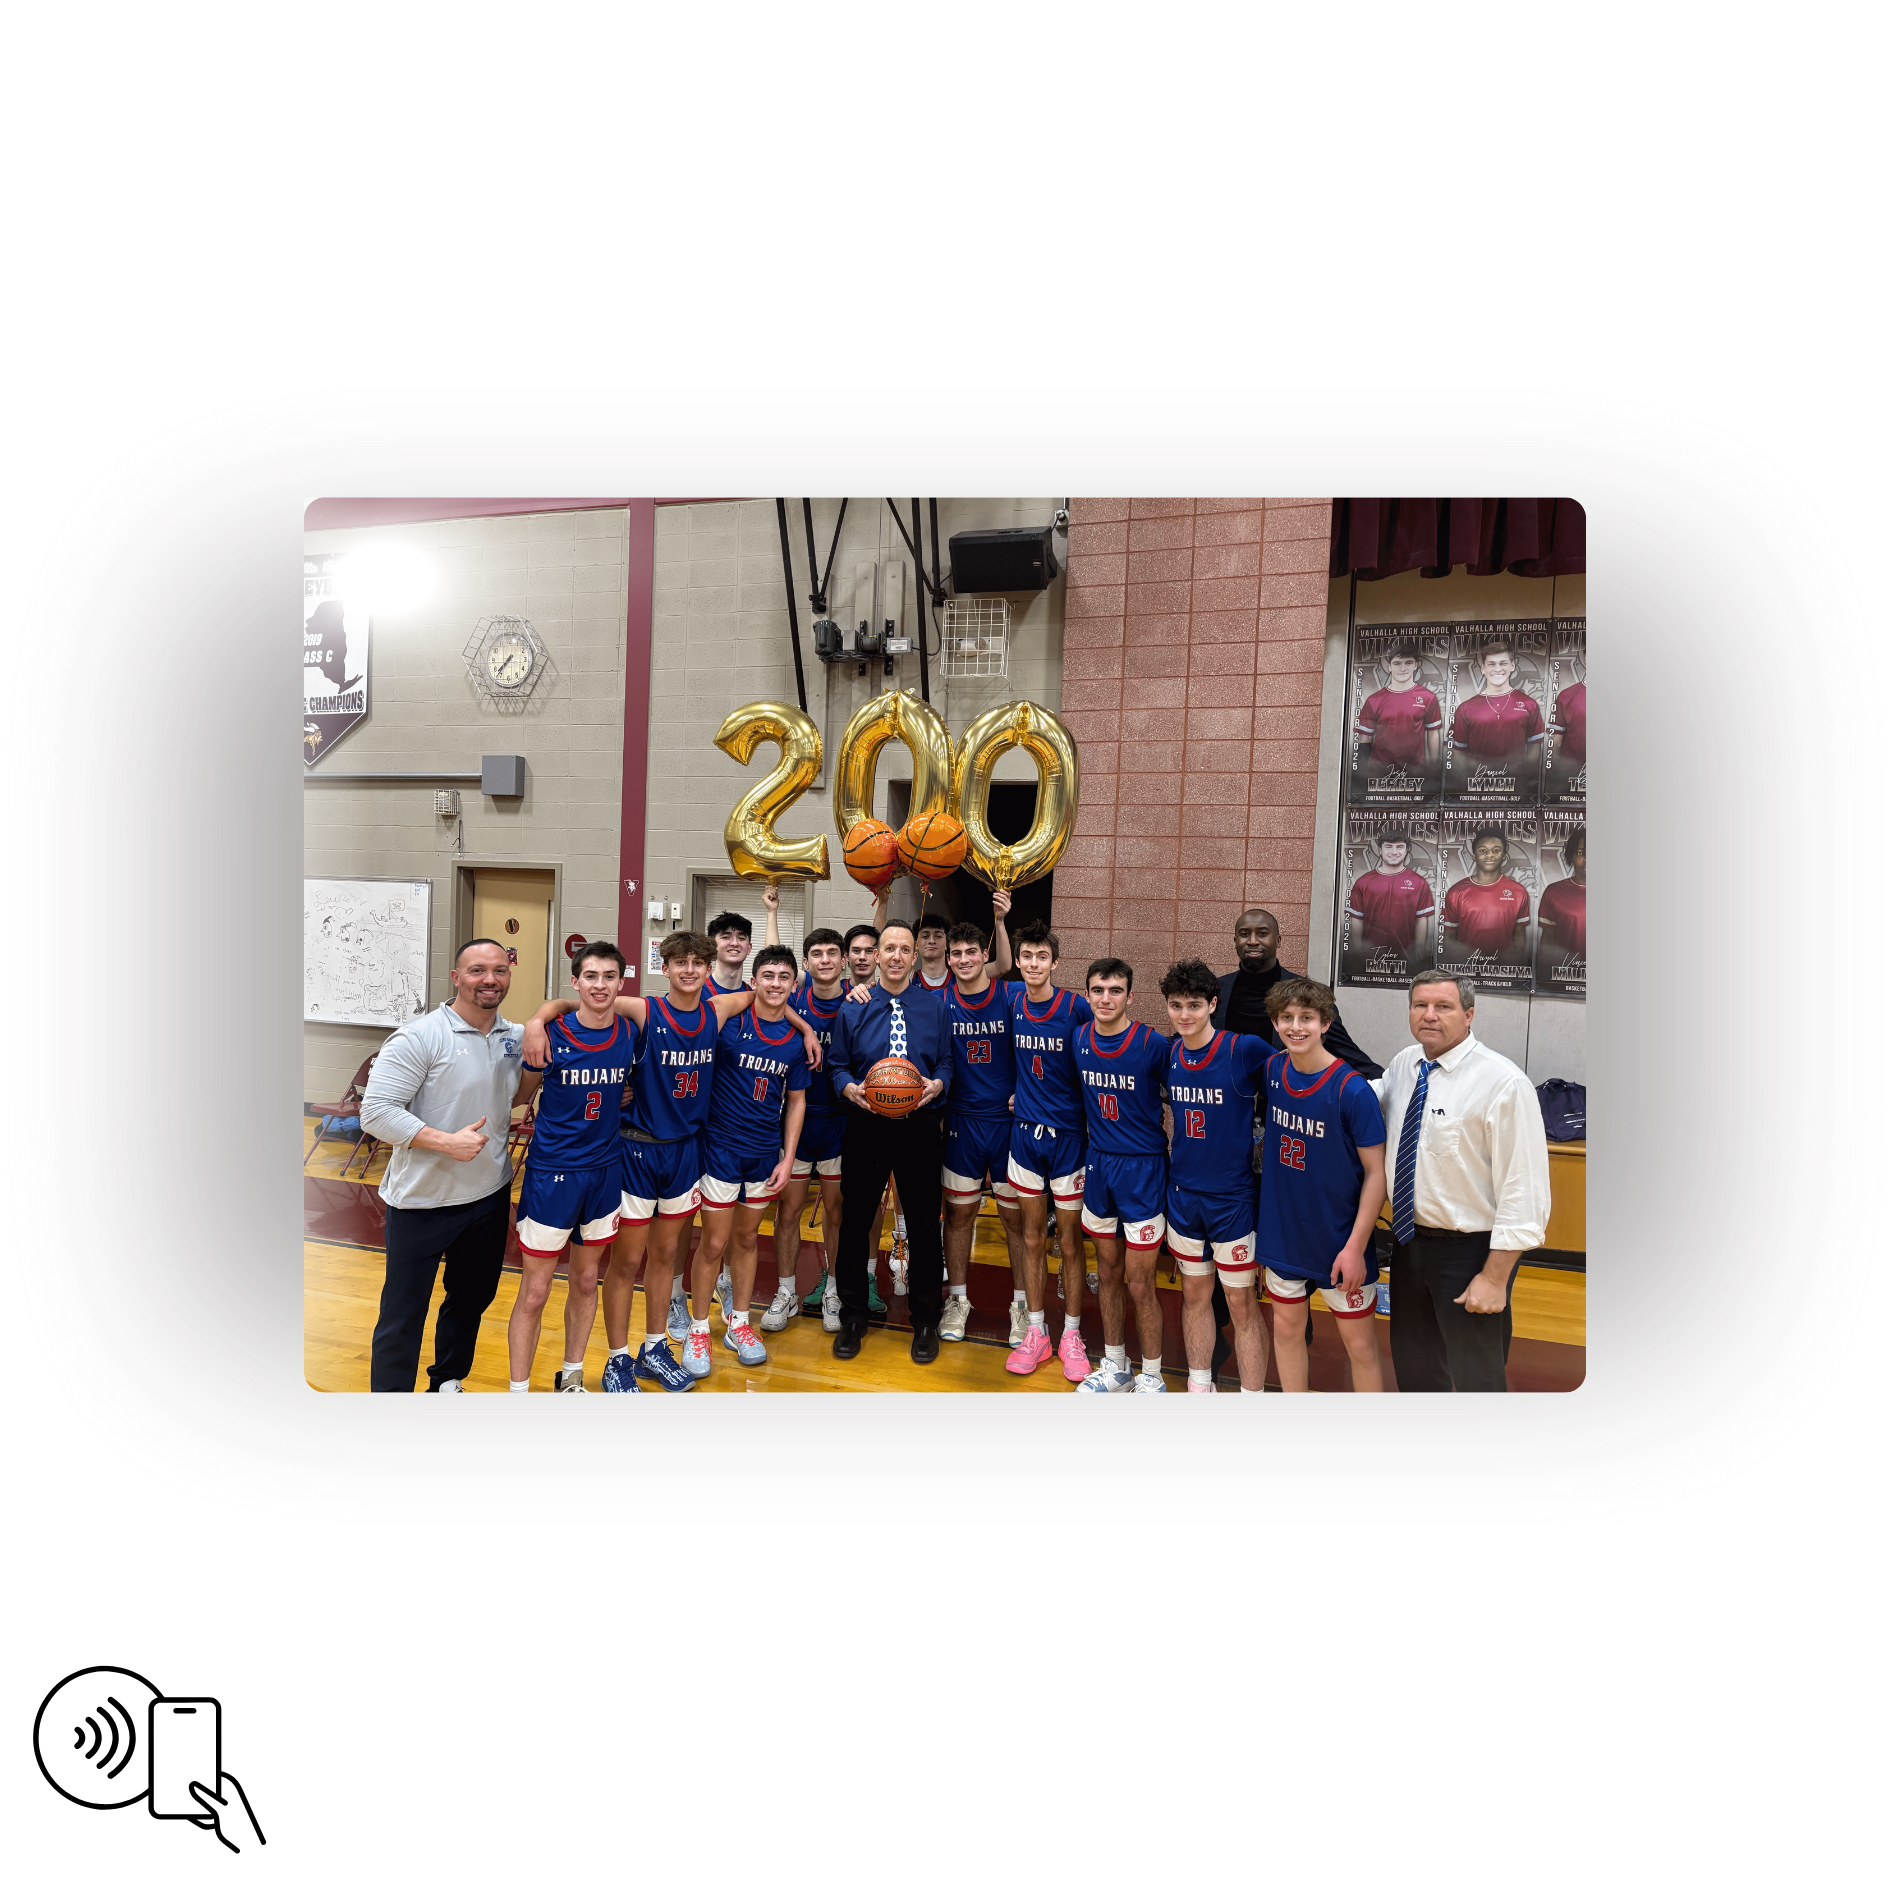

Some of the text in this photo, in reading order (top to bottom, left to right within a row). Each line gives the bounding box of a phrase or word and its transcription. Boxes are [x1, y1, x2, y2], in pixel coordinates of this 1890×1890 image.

[1360, 626, 1450, 637] VALHALLA HIGH SCHOOL
[1455, 622, 1547, 634] VALHALLA HIGH SCHOOL
[325, 650, 333, 663] C
[1454, 632, 1548, 657] VIKGS
[309, 690, 365, 713] CHAMPIONS
[1352, 668, 1363, 770] SENIOR 2025
[1446, 664, 1458, 770] SENIOR 2025
[1546, 661, 1560, 769] SENIOR 2025
[1467, 777, 1516, 792] LYNCH
[1350, 812, 1439, 820] VALHALLA HIGH SCHOOL
[1444, 811, 1537, 819] VALHALLA HIGH SCHOOL
[1544, 812, 1584, 820] VALHALLA
[1443, 820, 1538, 845] VIKGS
[1345, 849, 1353, 907] SENIOR
[1440, 849, 1448, 909] SENIOR
[952, 1020, 1005, 1036] TROJANS
[966, 1039, 992, 1064] 23
[1015, 1034, 1064, 1052] TROJANS
[661, 1048, 713, 1066] TROJANS
[738, 1053, 789, 1077] TROJANS
[1032, 1055, 1043, 1080] 4
[560, 1067, 625, 1085] TROJANS
[672, 1070, 699, 1098] 34
[1081, 1070, 1135, 1091] TROJANS
[753, 1076, 769, 1102] 11
[874, 1091, 915, 1104] Wilson
[1170, 1086, 1223, 1105] TROJANS
[584, 1091, 602, 1120] 2
[1098, 1092, 1119, 1121] 10
[1185, 1109, 1206, 1139] 12
[1272, 1105, 1326, 1139] TROJANS
[1280, 1134, 1305, 1171] 22
